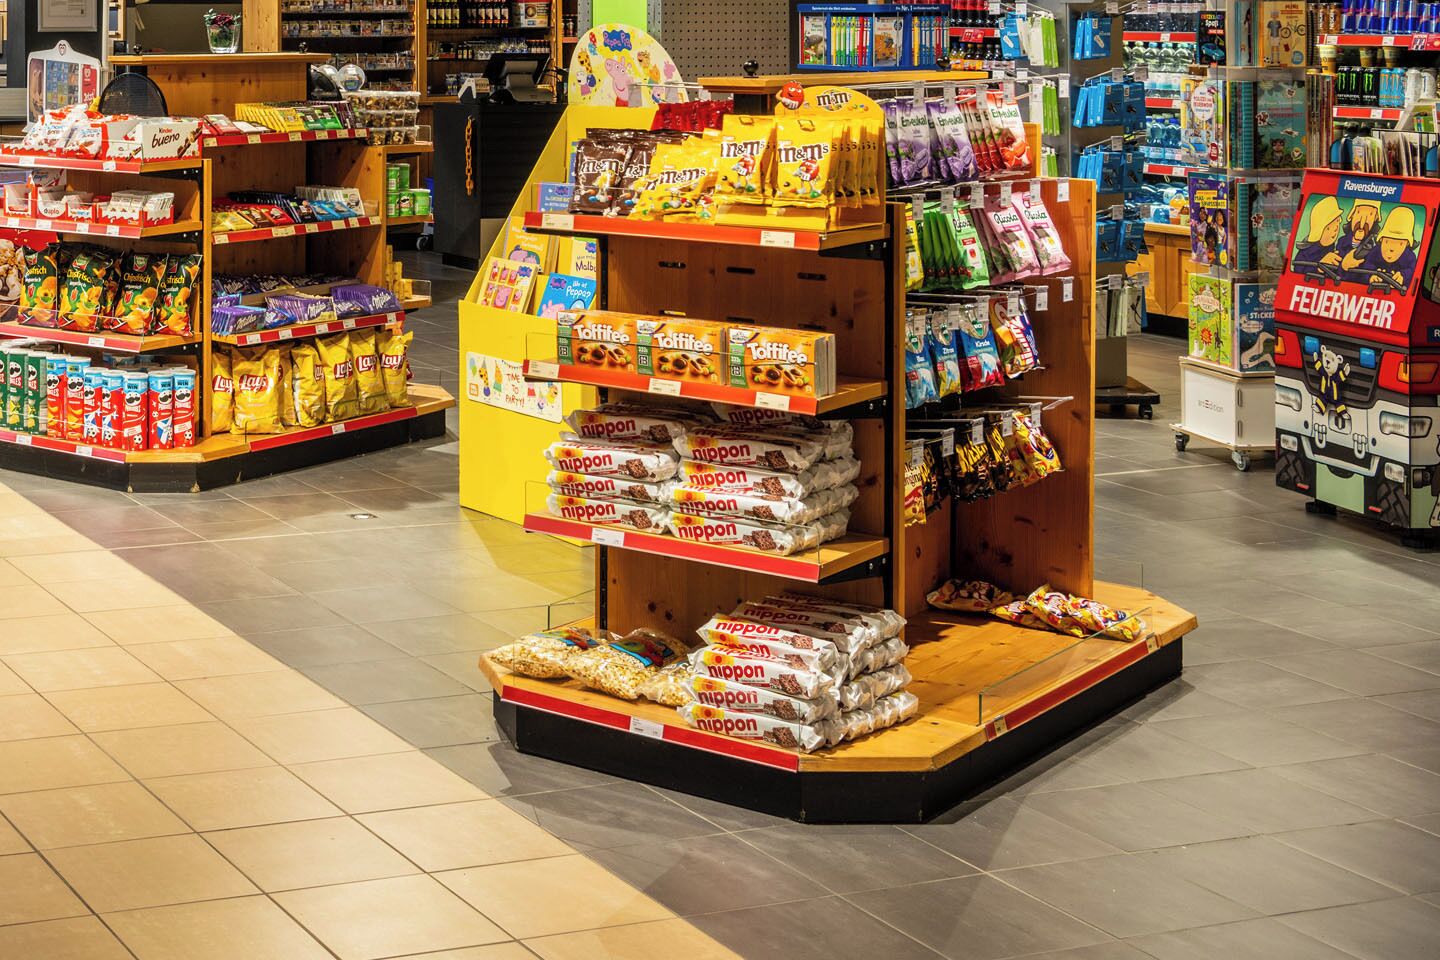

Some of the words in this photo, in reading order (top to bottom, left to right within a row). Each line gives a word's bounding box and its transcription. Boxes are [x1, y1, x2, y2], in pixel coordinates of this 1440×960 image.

[151, 132, 180, 149] bueno
[778, 143, 829, 162] m&m's
[1343, 179, 1397, 197] Ravensburger
[994, 213, 1018, 225] Ricola
[1024, 209, 1047, 221] Ricola
[123, 272, 151, 283] Chipsfrisch
[372, 291, 394, 309] Milka
[566, 285, 591, 299] Peppa?
[308, 302, 326, 317] Milka
[1289, 285, 1395, 329] FEUERWEHR
[236, 315, 257, 330] Milka
[574, 324, 630, 346] Toffifee
[654, 333, 713, 355] Toffifee
[747, 342, 809, 365] Toffifee
[505, 373, 521, 383] TIME
[511, 384, 520, 394] TO
[505, 393, 525, 408] PARTY!
[581, 417, 636, 438] nippon
[692, 443, 750, 463] nippon
[559, 452, 613, 473] nippon
[561, 478, 615, 497] nippon
[689, 470, 747, 489] nippon
[561, 501, 616, 522] nippon
[679, 498, 738, 517] nippon
[678, 522, 736, 541] nippon
[745, 607, 810, 622] nippon
[715, 621, 779, 635] nippon
[707, 664, 765, 680] nippon
[698, 690, 758, 707] nippon
[696, 717, 757, 734] nippon
